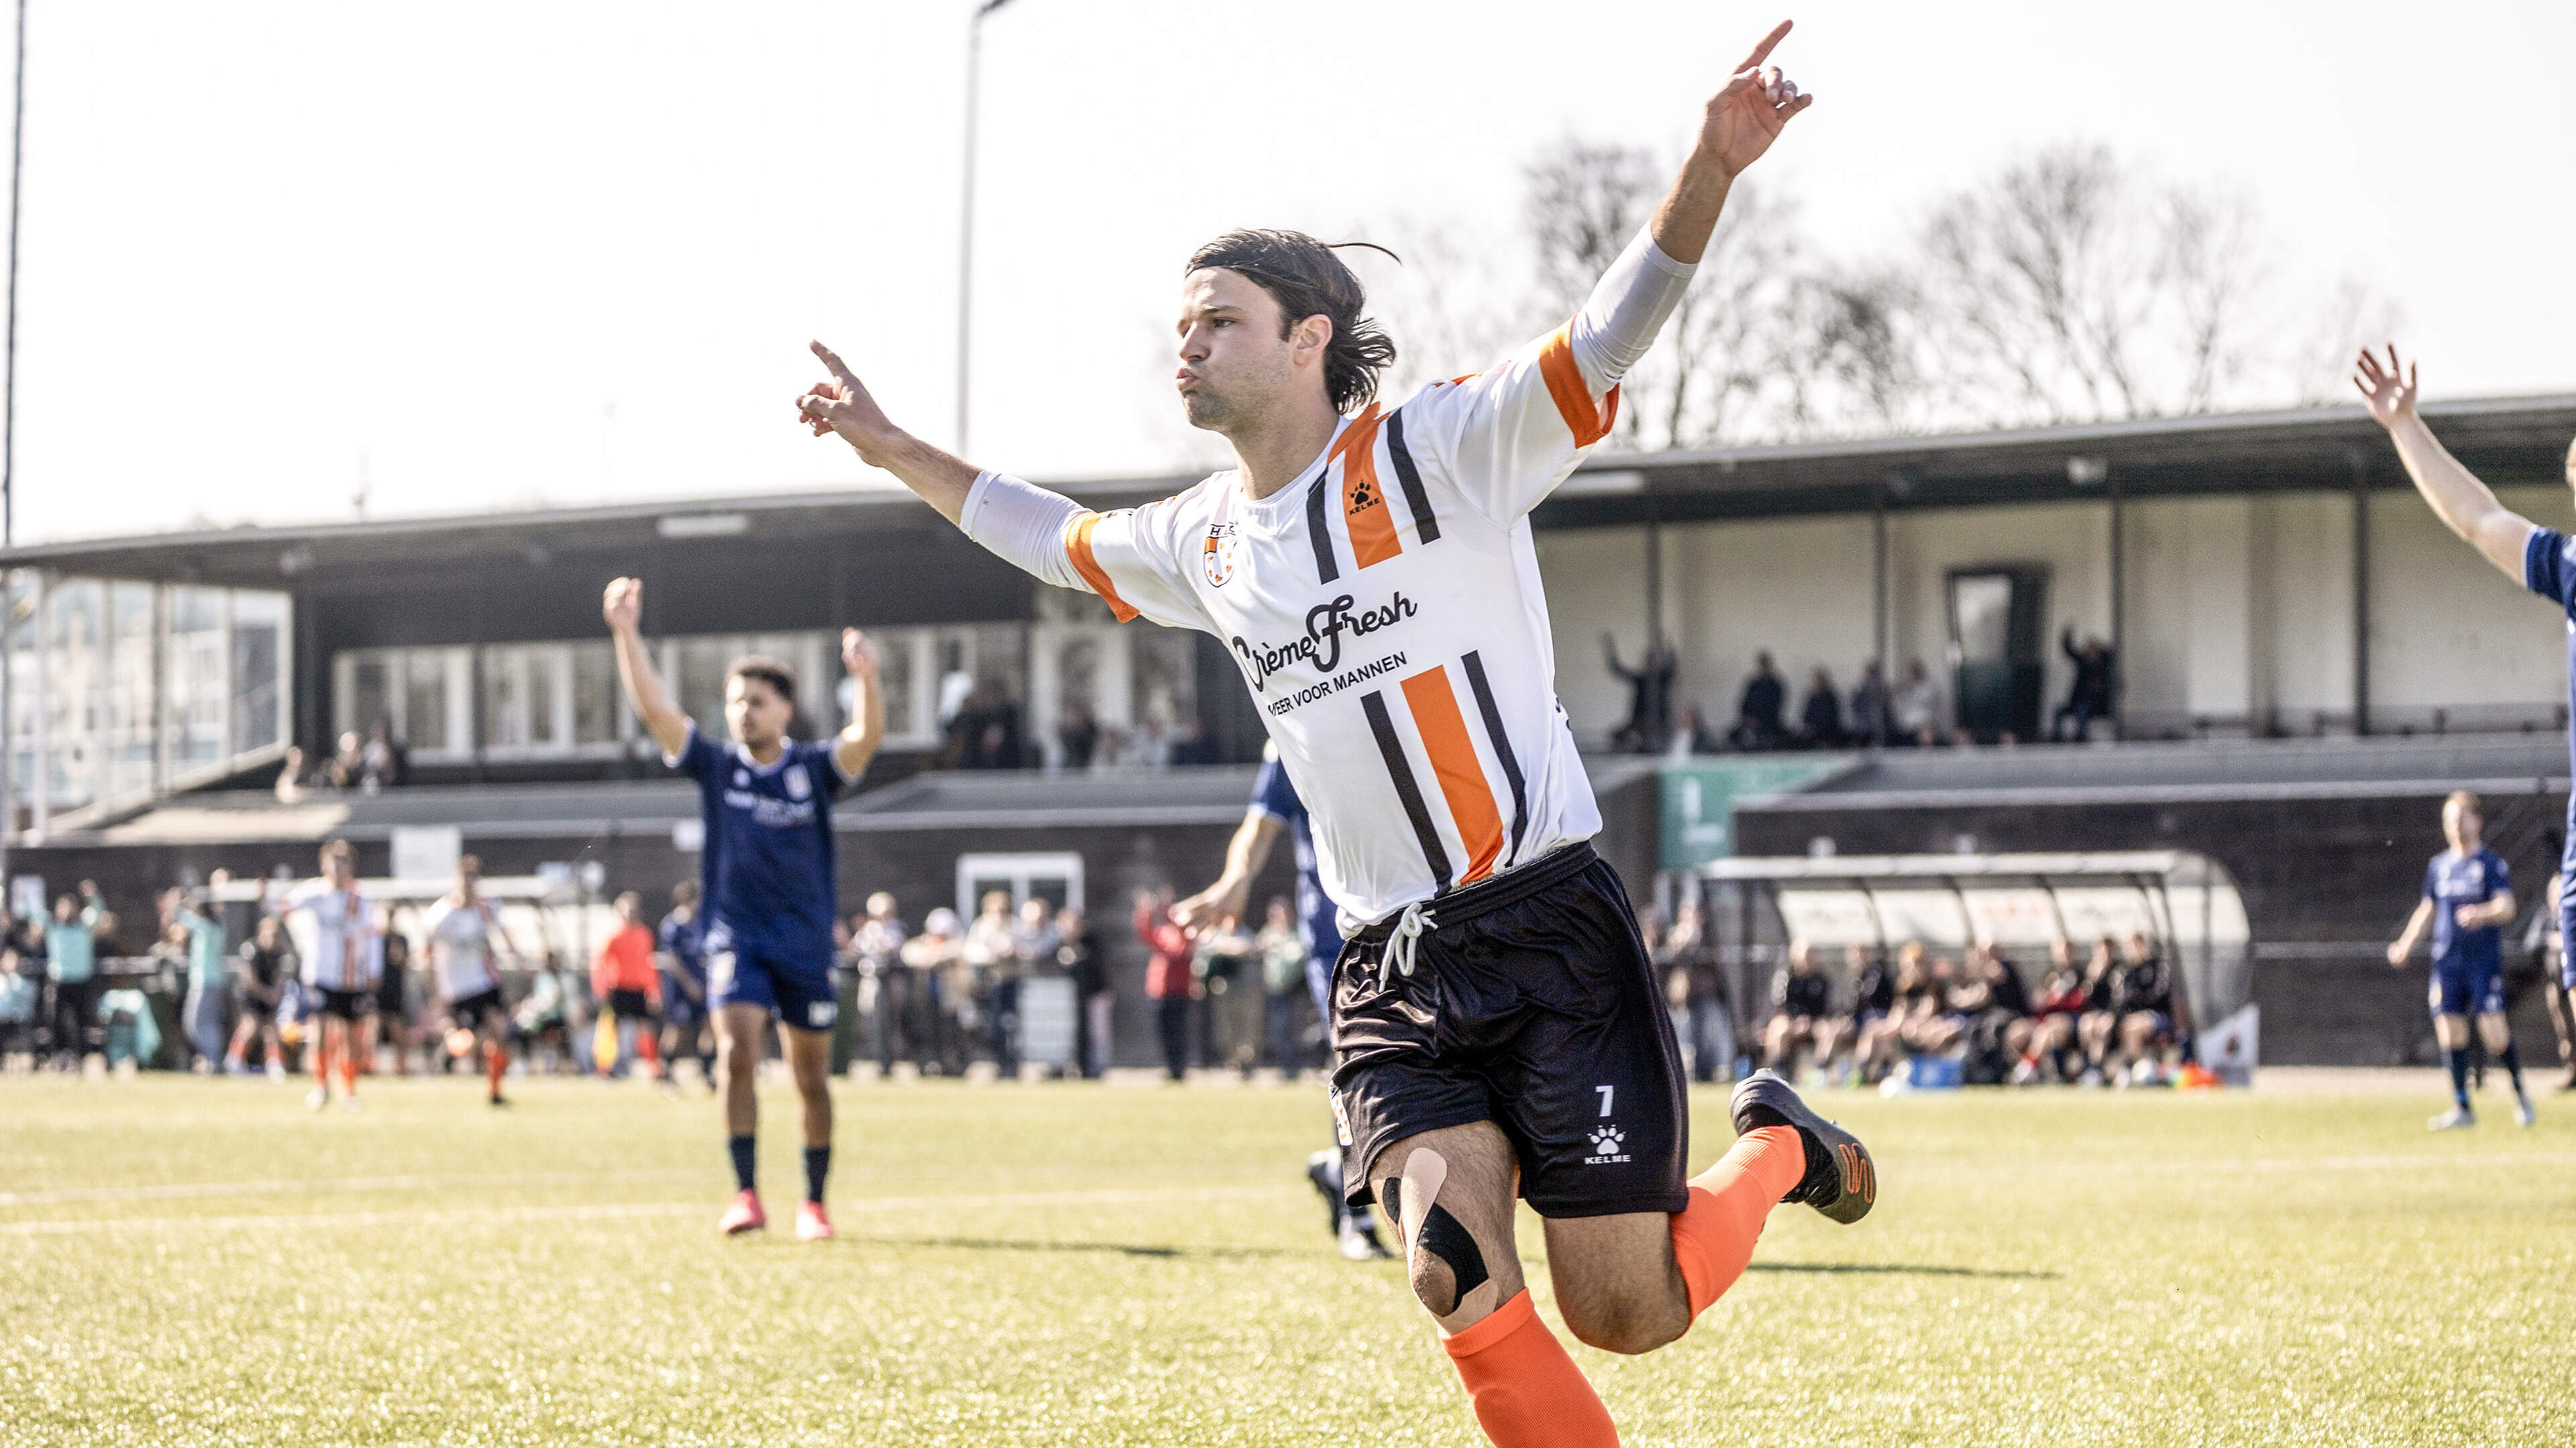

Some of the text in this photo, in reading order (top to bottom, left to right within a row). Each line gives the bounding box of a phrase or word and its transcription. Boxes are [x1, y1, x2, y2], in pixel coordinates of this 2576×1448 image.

[1349, 498, 1380, 516] KELME
[1293, 681, 1332, 706] VOOR
[1332, 651, 1407, 691] MANNEN
[1595, 1085, 1613, 1117] 7
[1585, 1154, 1631, 1164] KELME
